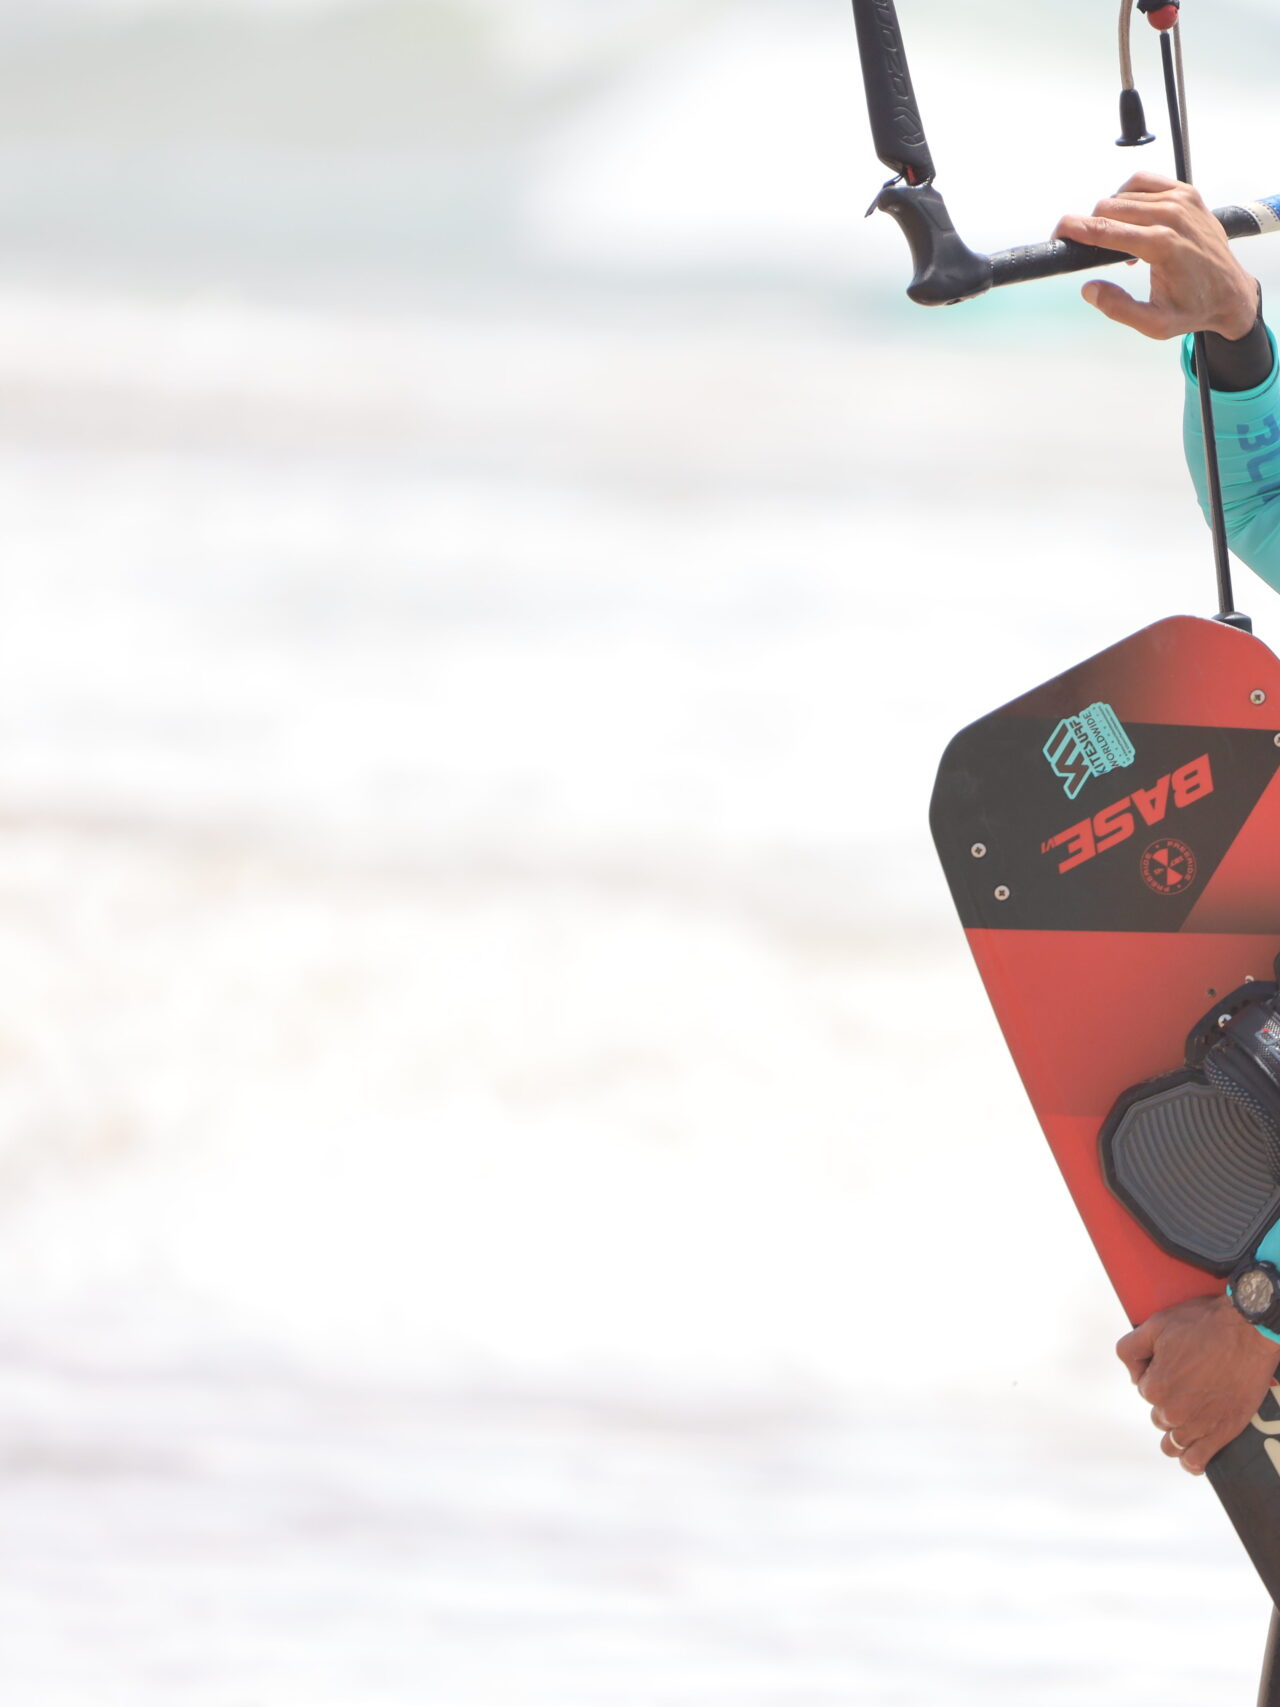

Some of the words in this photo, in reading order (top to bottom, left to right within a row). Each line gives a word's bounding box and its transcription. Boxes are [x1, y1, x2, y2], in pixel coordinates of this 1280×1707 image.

[1069, 719, 1106, 774] KITESURF
[1083, 711, 1119, 768] WORLDWIDE
[1058, 753, 1214, 875] BASE
